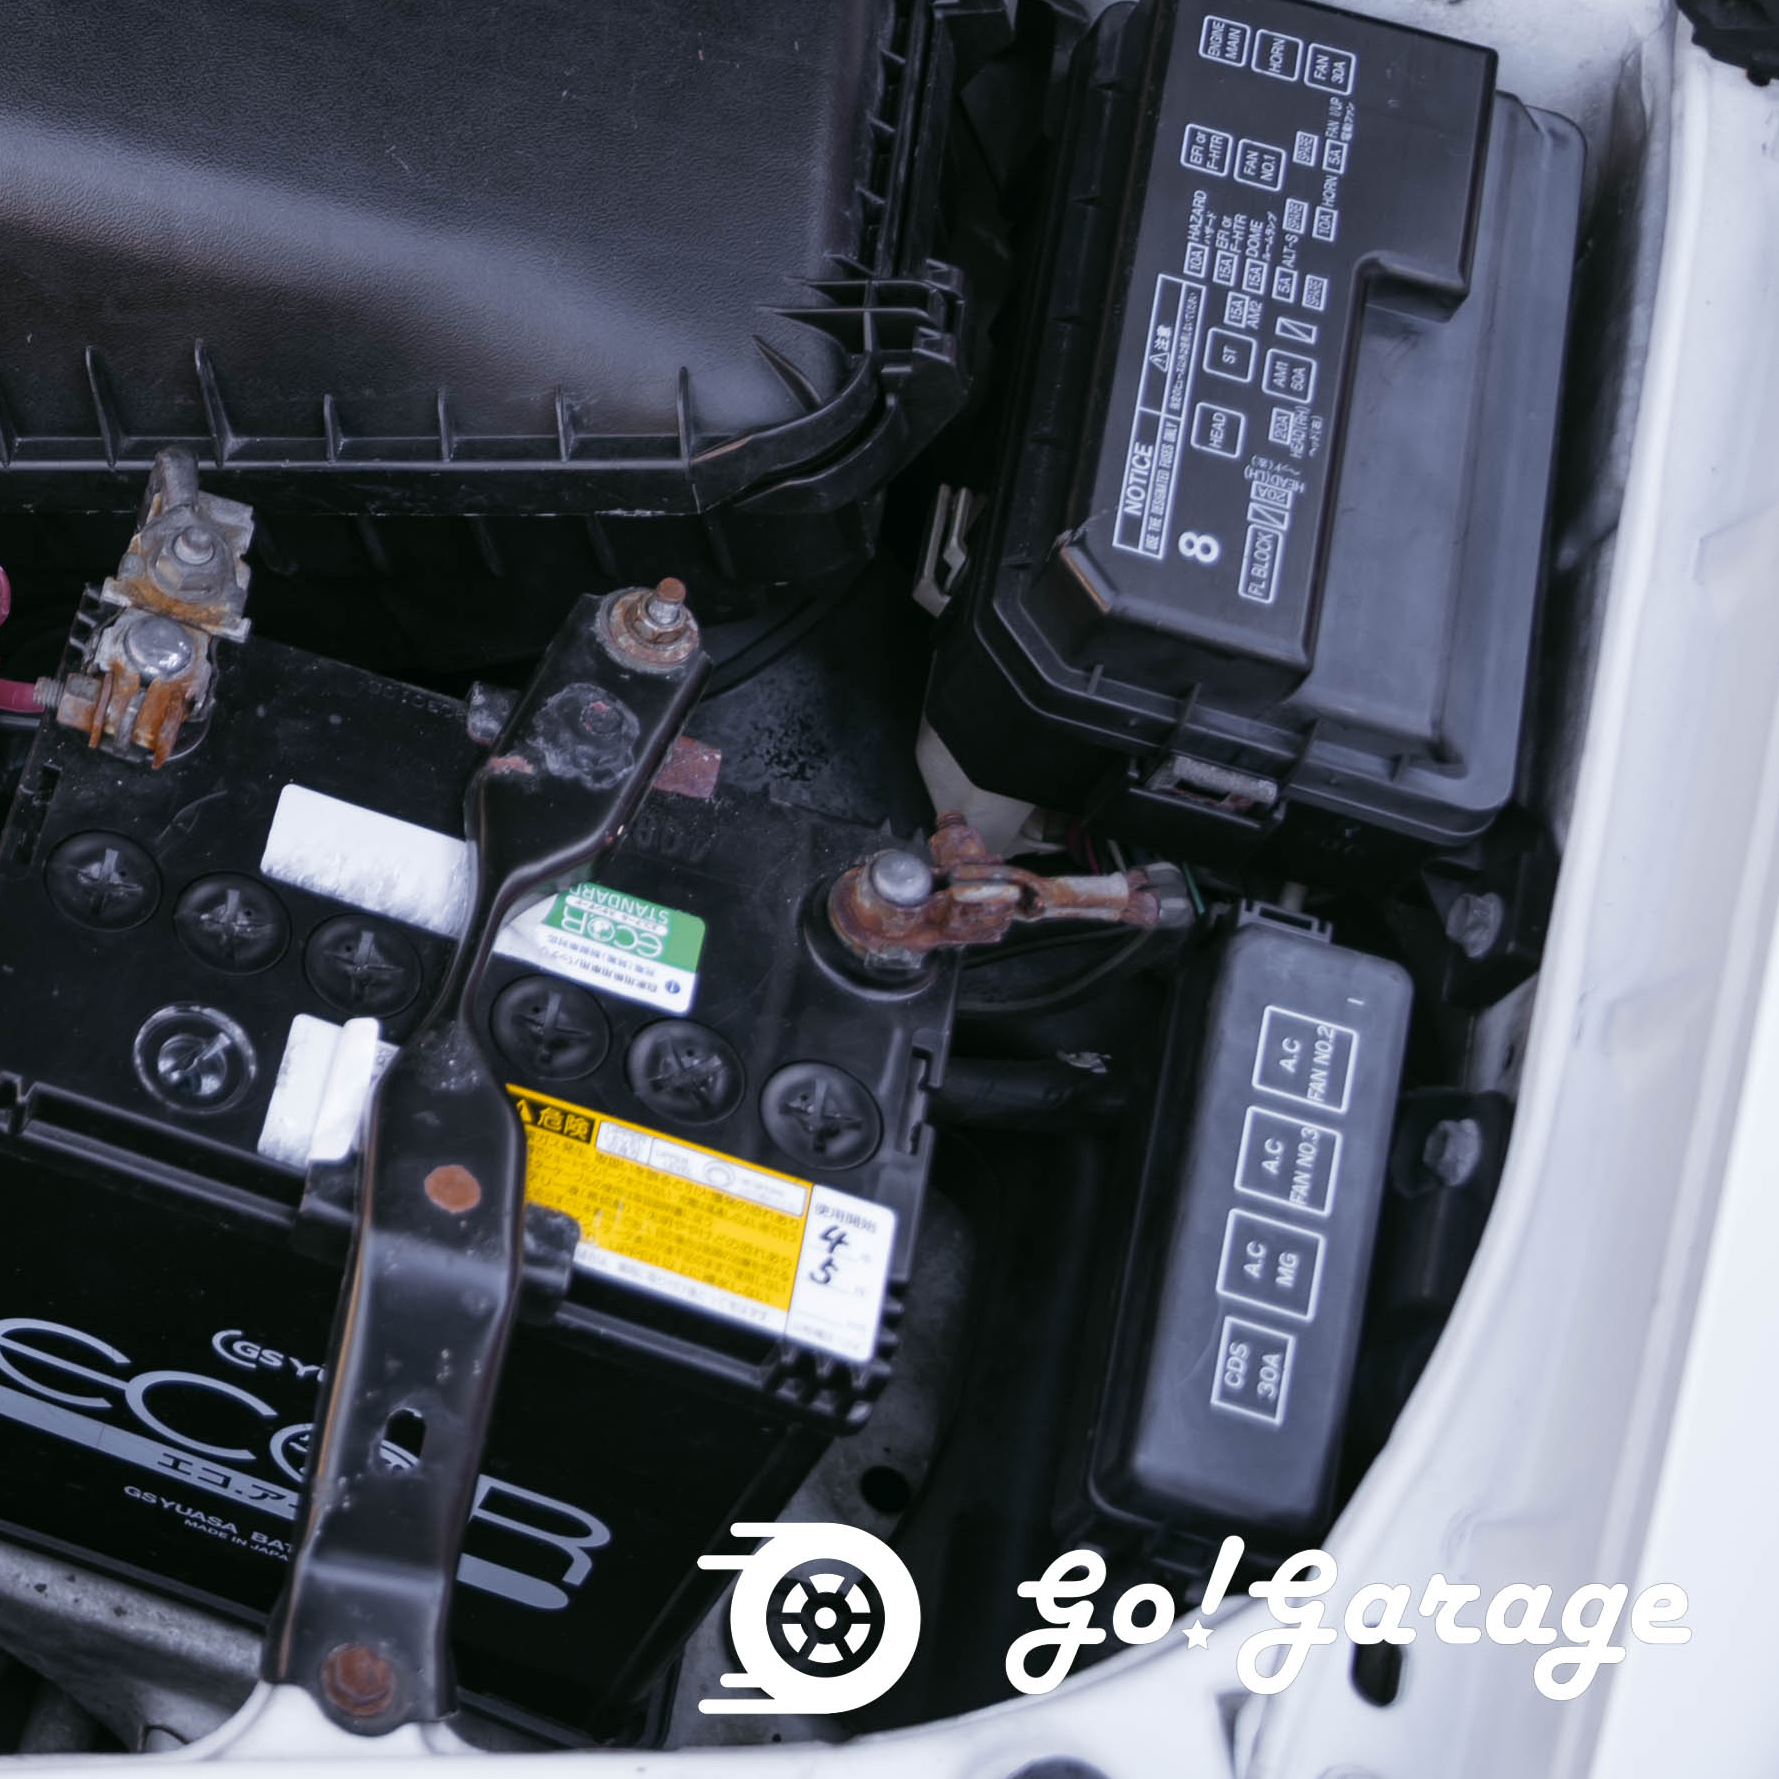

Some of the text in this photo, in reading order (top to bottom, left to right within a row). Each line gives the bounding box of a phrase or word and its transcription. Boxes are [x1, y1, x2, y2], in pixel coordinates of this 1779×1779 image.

[1208, 20, 1226, 57] ENGINE
[1225, 27, 1242, 60] MAIN
[1269, 37, 1286, 73] HORN
[1313, 54, 1330, 80] FAN
[1325, 120, 1341, 138] FAN
[1190, 144, 1204, 164] EFI
[1207, 134, 1224, 170] F-HTR
[1243, 149, 1260, 176] FAN
[1260, 154, 1277, 181] NO.1
[1328, 149, 1342, 166] 5A
[1321, 175, 1338, 206] HORN
[1187, 190, 1207, 241] HAZARD
[1318, 214, 1333, 234] 10A
[1215, 215, 1232, 249] EFI or
[1230, 213, 1247, 253] F-HTR
[1246, 219, 1264, 258] DOME
[1189, 250, 1204, 271] 10A
[1281, 234, 1299, 268] ALT-S
[1219, 257, 1234, 279] 15A
[1248, 266, 1263, 287] 15A
[1278, 277, 1291, 294] 5A
[1231, 299, 1245, 320] 15A
[1247, 300, 1263, 330] AM2
[1222, 345, 1237, 365] ST
[1209, 411, 1227, 450] HEAD
[1159, 444, 1176, 470] FUSES
[1123, 441, 1155, 517] NOTICE
[1256, 485, 1288, 504] 20A
[1148, 515, 1163, 533] THE
[1144, 532, 1160, 552] USE
[1178, 531, 1220, 564] 8
[1248, 532, 1274, 598] FL BLOCK
[1308, 1024, 1337, 1105] FAN NO.2
[536, 1106, 592, 1142] 危険
[1290, 1126, 1320, 1207] FAN NO.3
[817, 1224, 849, 1255] 4
[808, 1255, 839, 1287] 5
[1275, 1251, 1301, 1288] MG
[1223, 1341, 1251, 1390] CDS
[1257, 1351, 1282, 1399] 30A
[184, 1519, 228, 1540] MADE
[231, 1536, 247, 1548] IN
[249, 1543, 291, 1563] JAPA
